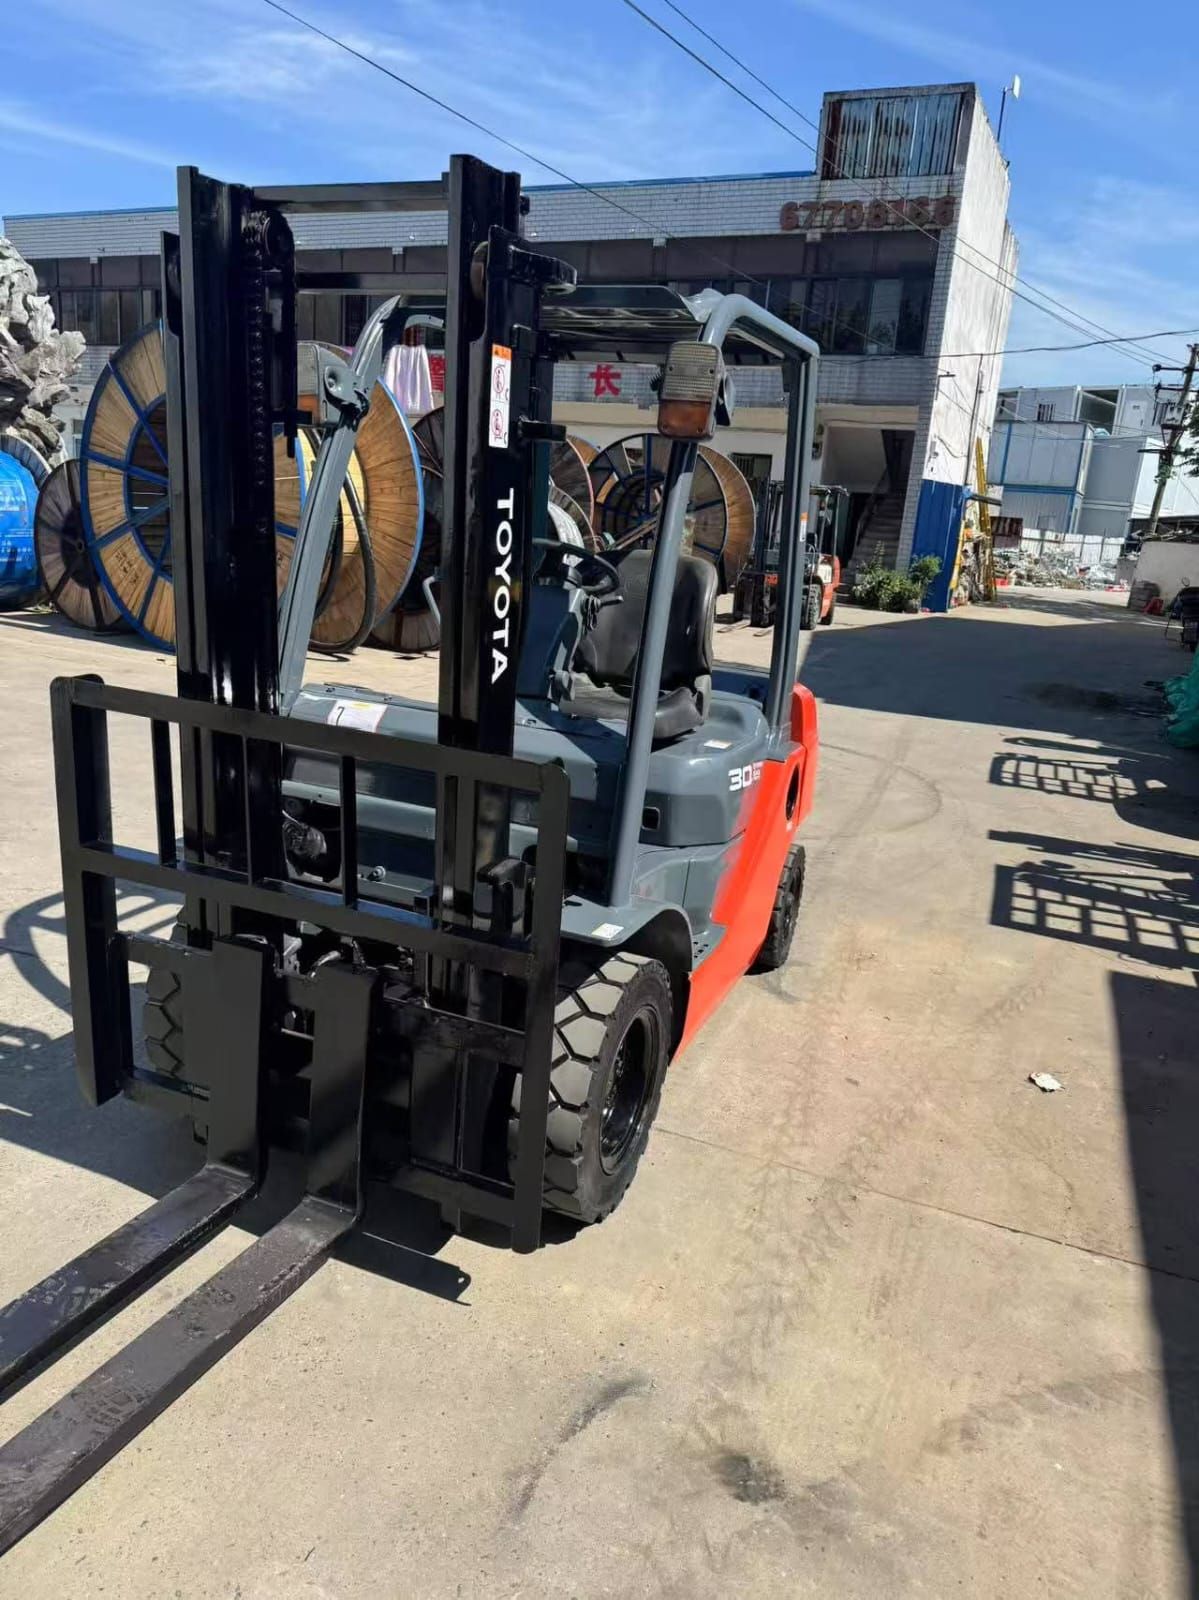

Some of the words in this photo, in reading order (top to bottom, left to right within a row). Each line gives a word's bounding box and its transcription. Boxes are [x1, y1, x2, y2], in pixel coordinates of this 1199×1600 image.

[588, 364, 621, 397] 长
[492, 487, 515, 685] TOYOTA
[728, 765, 753, 792] 30
